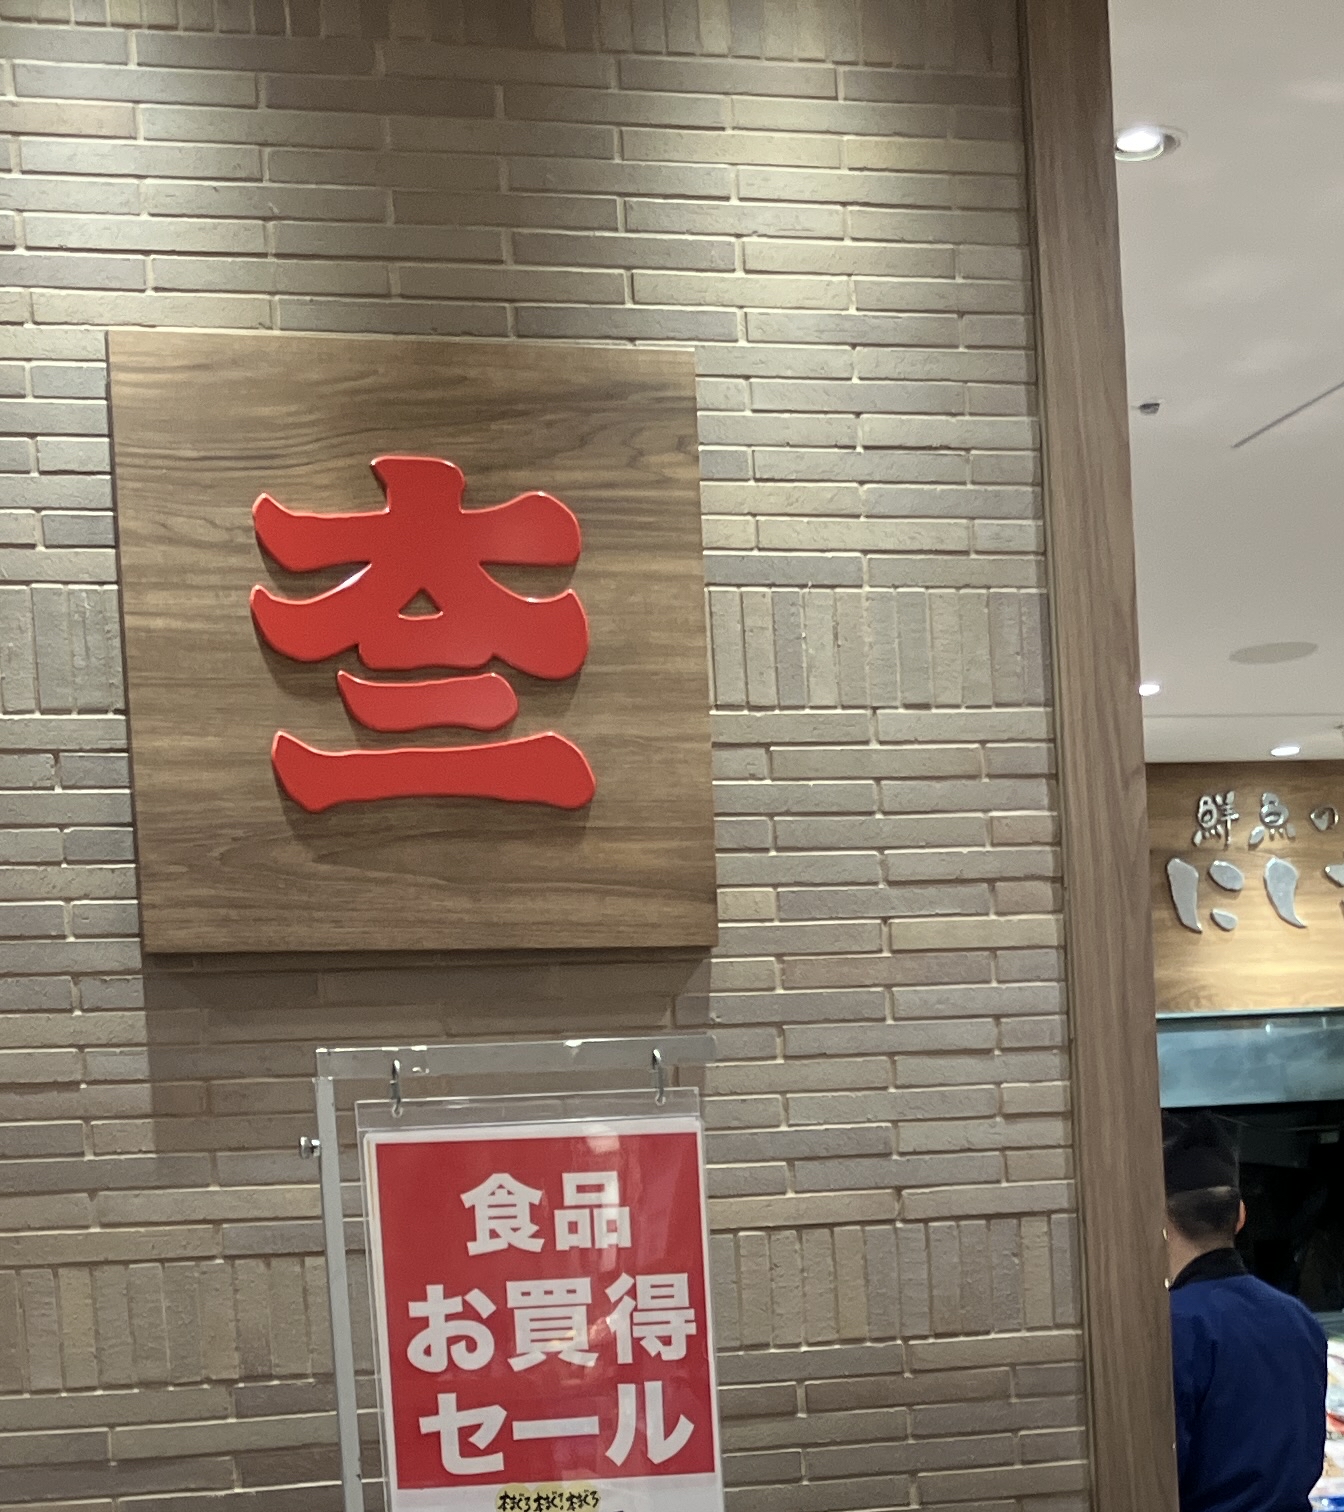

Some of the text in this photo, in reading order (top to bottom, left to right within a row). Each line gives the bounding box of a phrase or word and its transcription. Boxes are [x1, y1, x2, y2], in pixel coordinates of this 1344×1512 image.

[460, 1170, 633, 1257] 食品
[406, 1271, 698, 1375] お買得
[418, 1380, 696, 1476] セール
